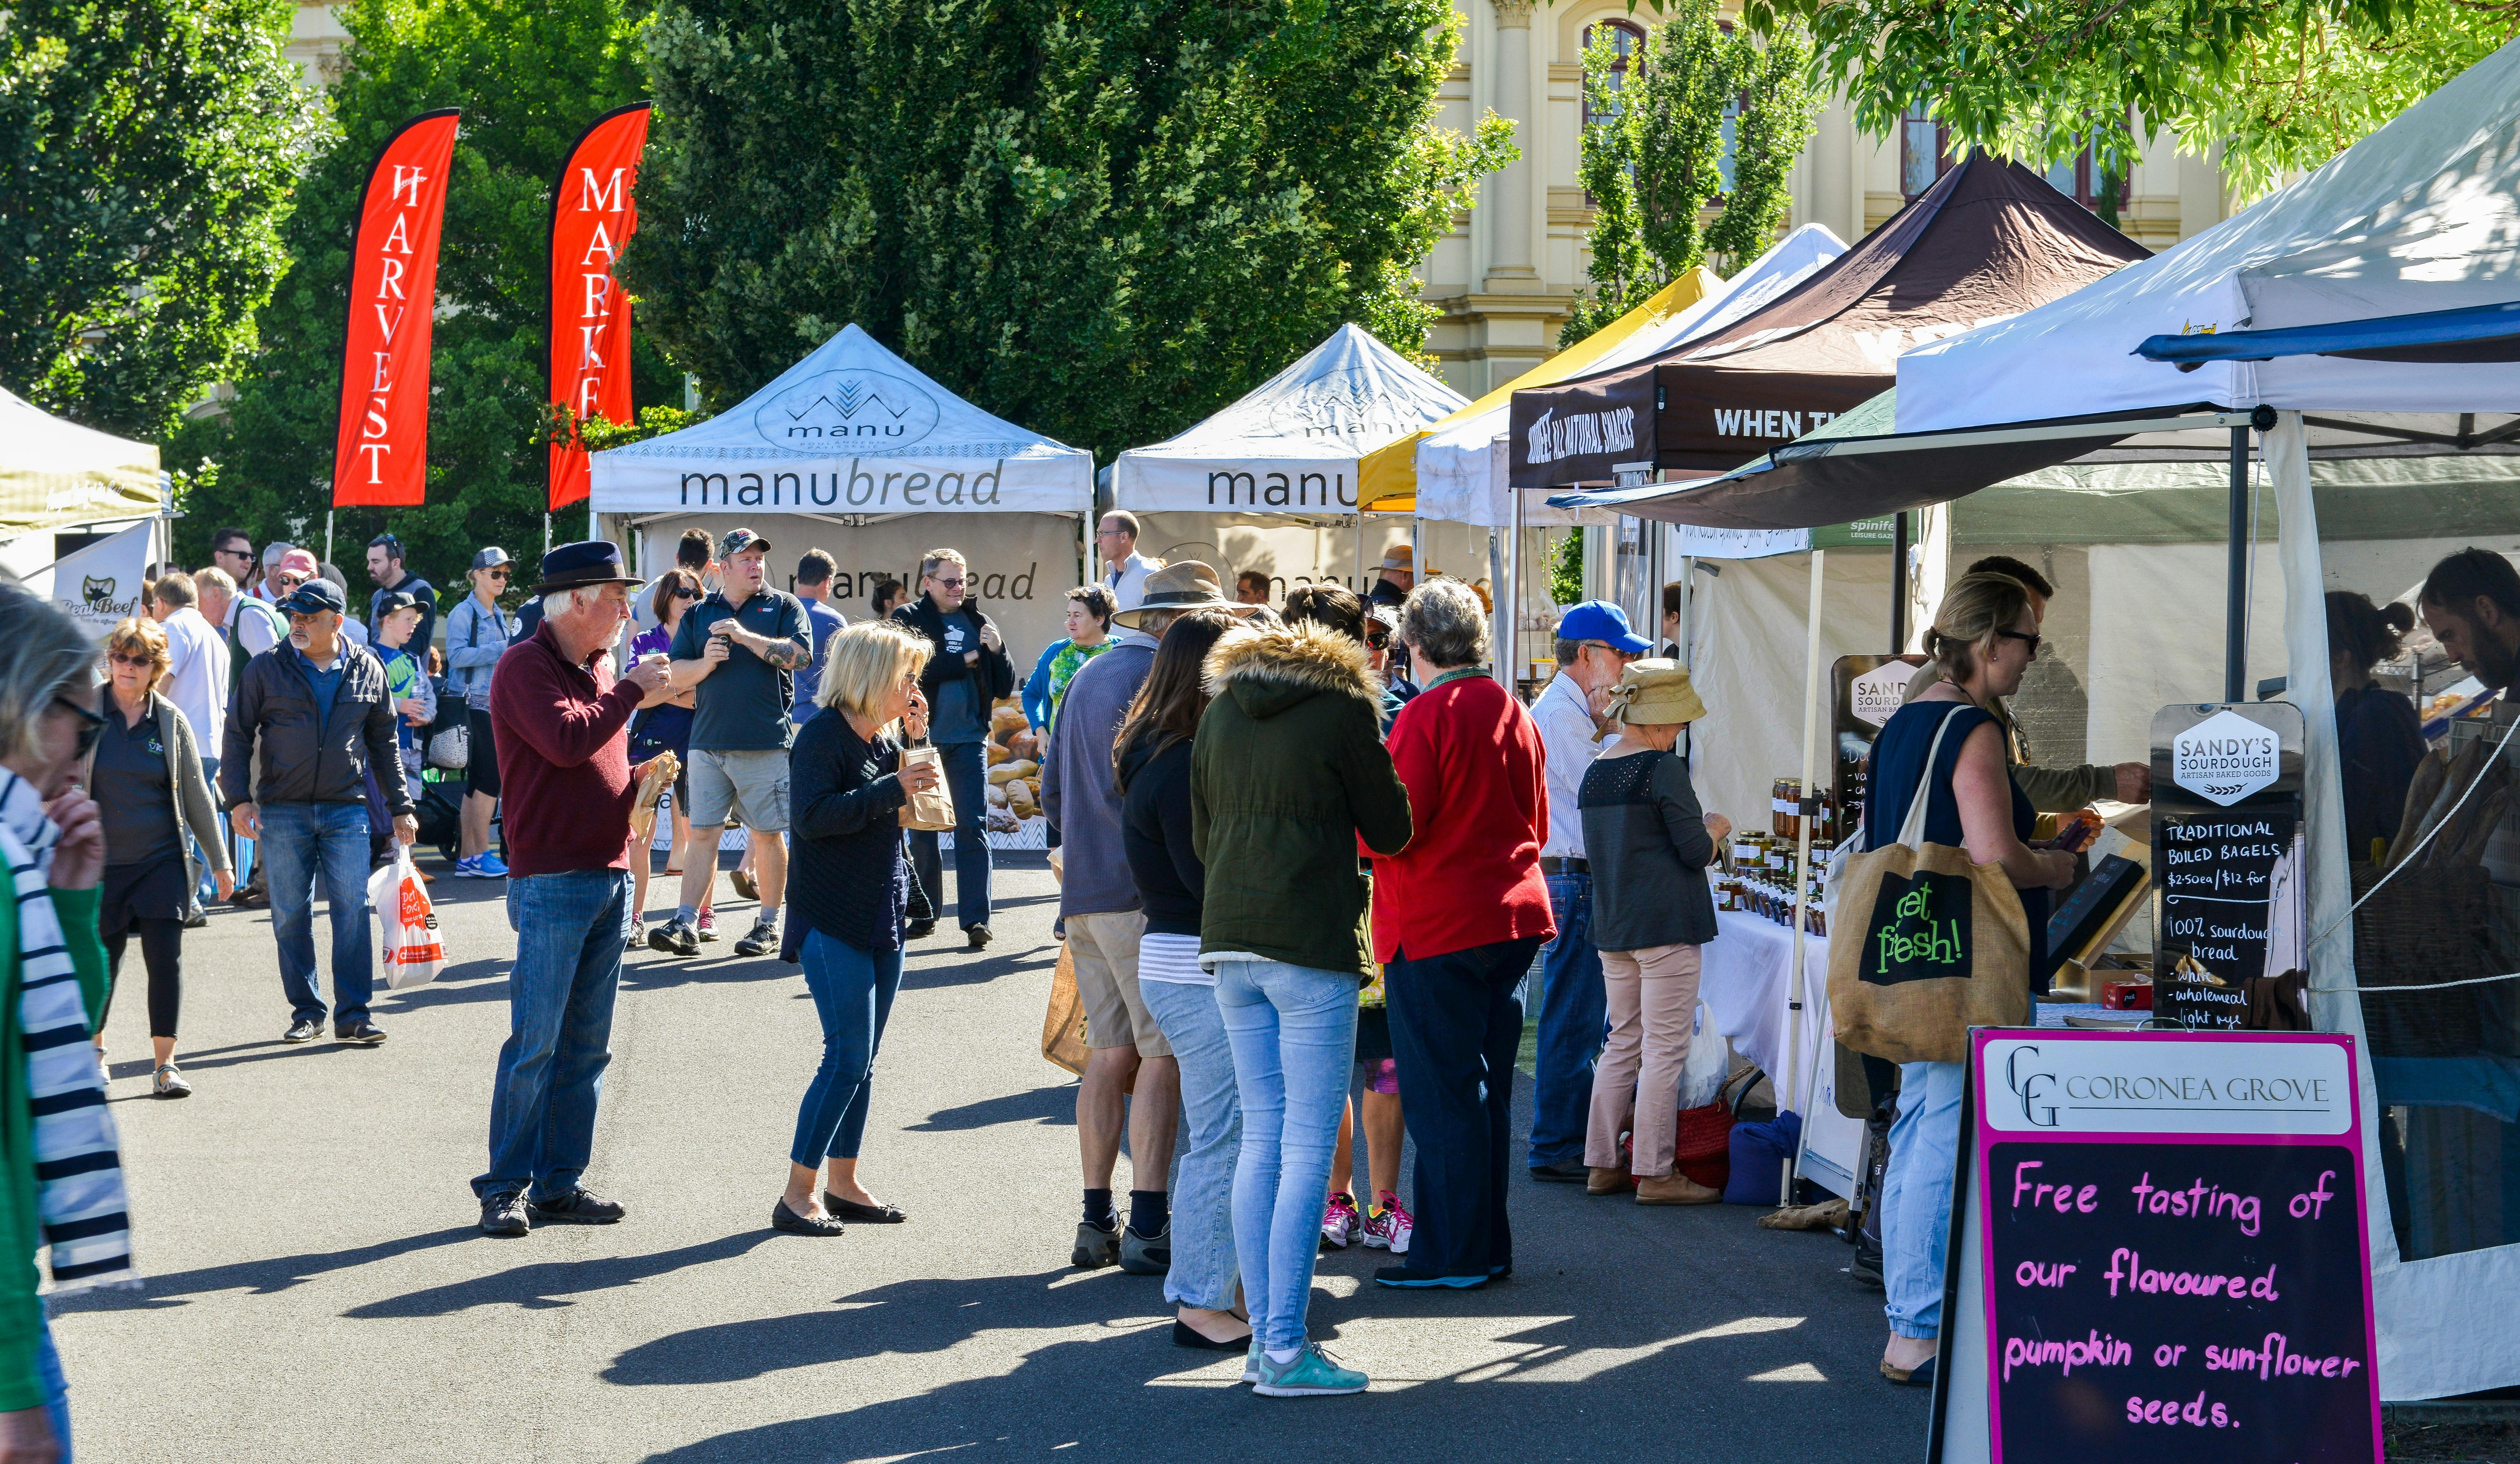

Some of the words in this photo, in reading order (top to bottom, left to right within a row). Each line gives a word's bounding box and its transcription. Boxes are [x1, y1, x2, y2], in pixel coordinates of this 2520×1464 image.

[360, 165, 423, 483] HARVEST
[579, 167, 626, 472] MARKE
[788, 425, 904, 438] manu
[1306, 422, 1419, 438] manu
[1552, 420, 1565, 460] ALL
[1564, 413, 1602, 456] NATURAL
[1601, 406, 1634, 453] SNACKS
[1714, 409, 1801, 438] WHEN
[681, 458, 1003, 506] manubread
[1208, 472, 1358, 508] manu
[97, 596, 138, 617] Beef
[2181, 738, 2272, 757] SANDY'S
[2181, 757, 2271, 770] SOURDOUGH
[2166, 821, 2274, 840] TRADITIONAL
[2168, 848, 2212, 864] BOILED
[2221, 844, 2280, 860] BAGELS
[2246, 871, 2266, 885] for
[1877, 919, 1962, 973] fresh!
[2170, 917, 2205, 937] 100%
[2210, 923, 2285, 951] sourdough
[2192, 941, 2239, 961] bread
[2217, 1014, 2241, 1030] rye
[2066, 1076, 2217, 1101] CORONEA
[2226, 1078, 2329, 1102] GROVE
[2013, 1160, 2098, 1213] Free
[2131, 1172, 2261, 1237] tasting
[2289, 1170, 2336, 1220] of
[2016, 1259, 2076, 1289] our
[2104, 1247, 2279, 1301] flavoured
[2004, 1328, 2132, 1383] pumpkin
[2153, 1343, 2187, 1367] or
[2205, 1332, 2361, 1382] sunflower
[2126, 1390, 2240, 1428] seeds.
